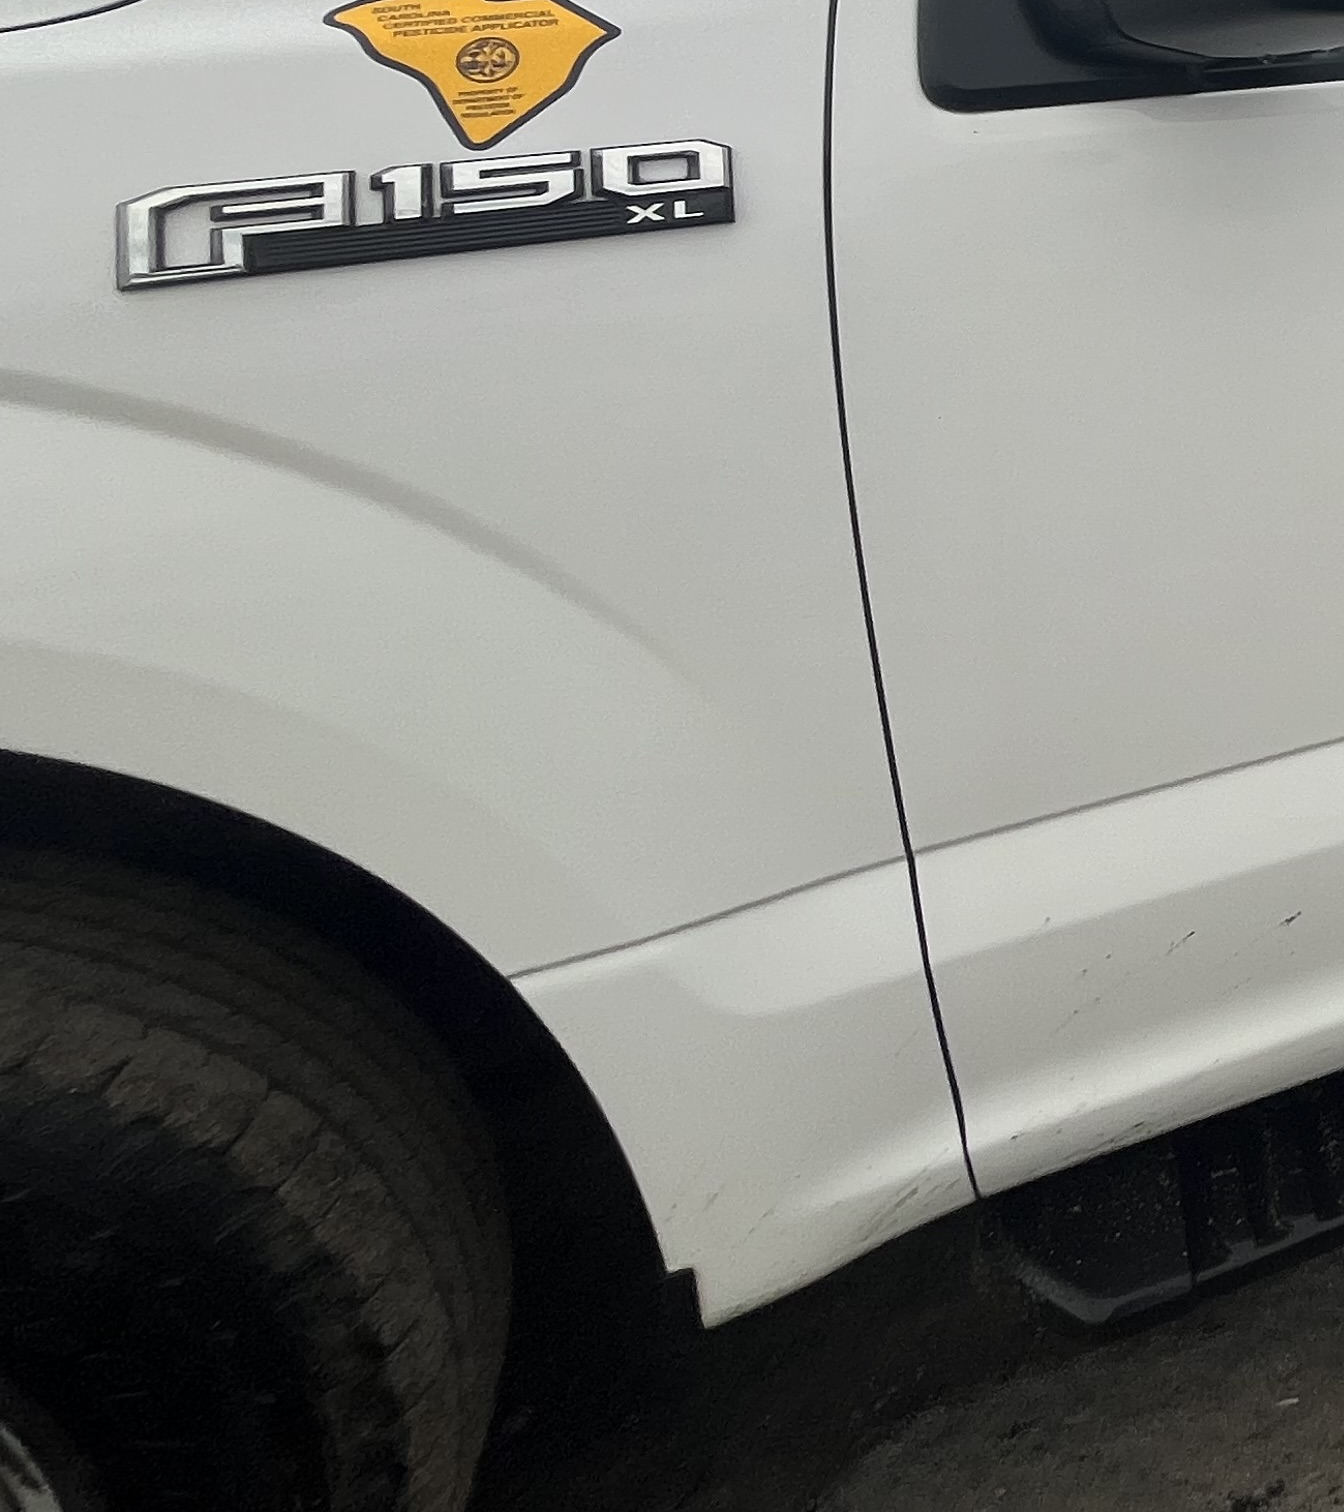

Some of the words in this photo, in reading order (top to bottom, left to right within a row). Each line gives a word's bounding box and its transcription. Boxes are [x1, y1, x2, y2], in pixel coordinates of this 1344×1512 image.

[372, 4, 421, 14] SOUTH
[377, 10, 450, 22] CAROLINA
[382, 18, 456, 30] CERTIFIED
[461, 9, 555, 23] COMMERCIAL
[393, 25, 468, 37] PESTICIDE
[471, 18, 559, 32] APPLICATOR
[626, 202, 705, 225] XL
